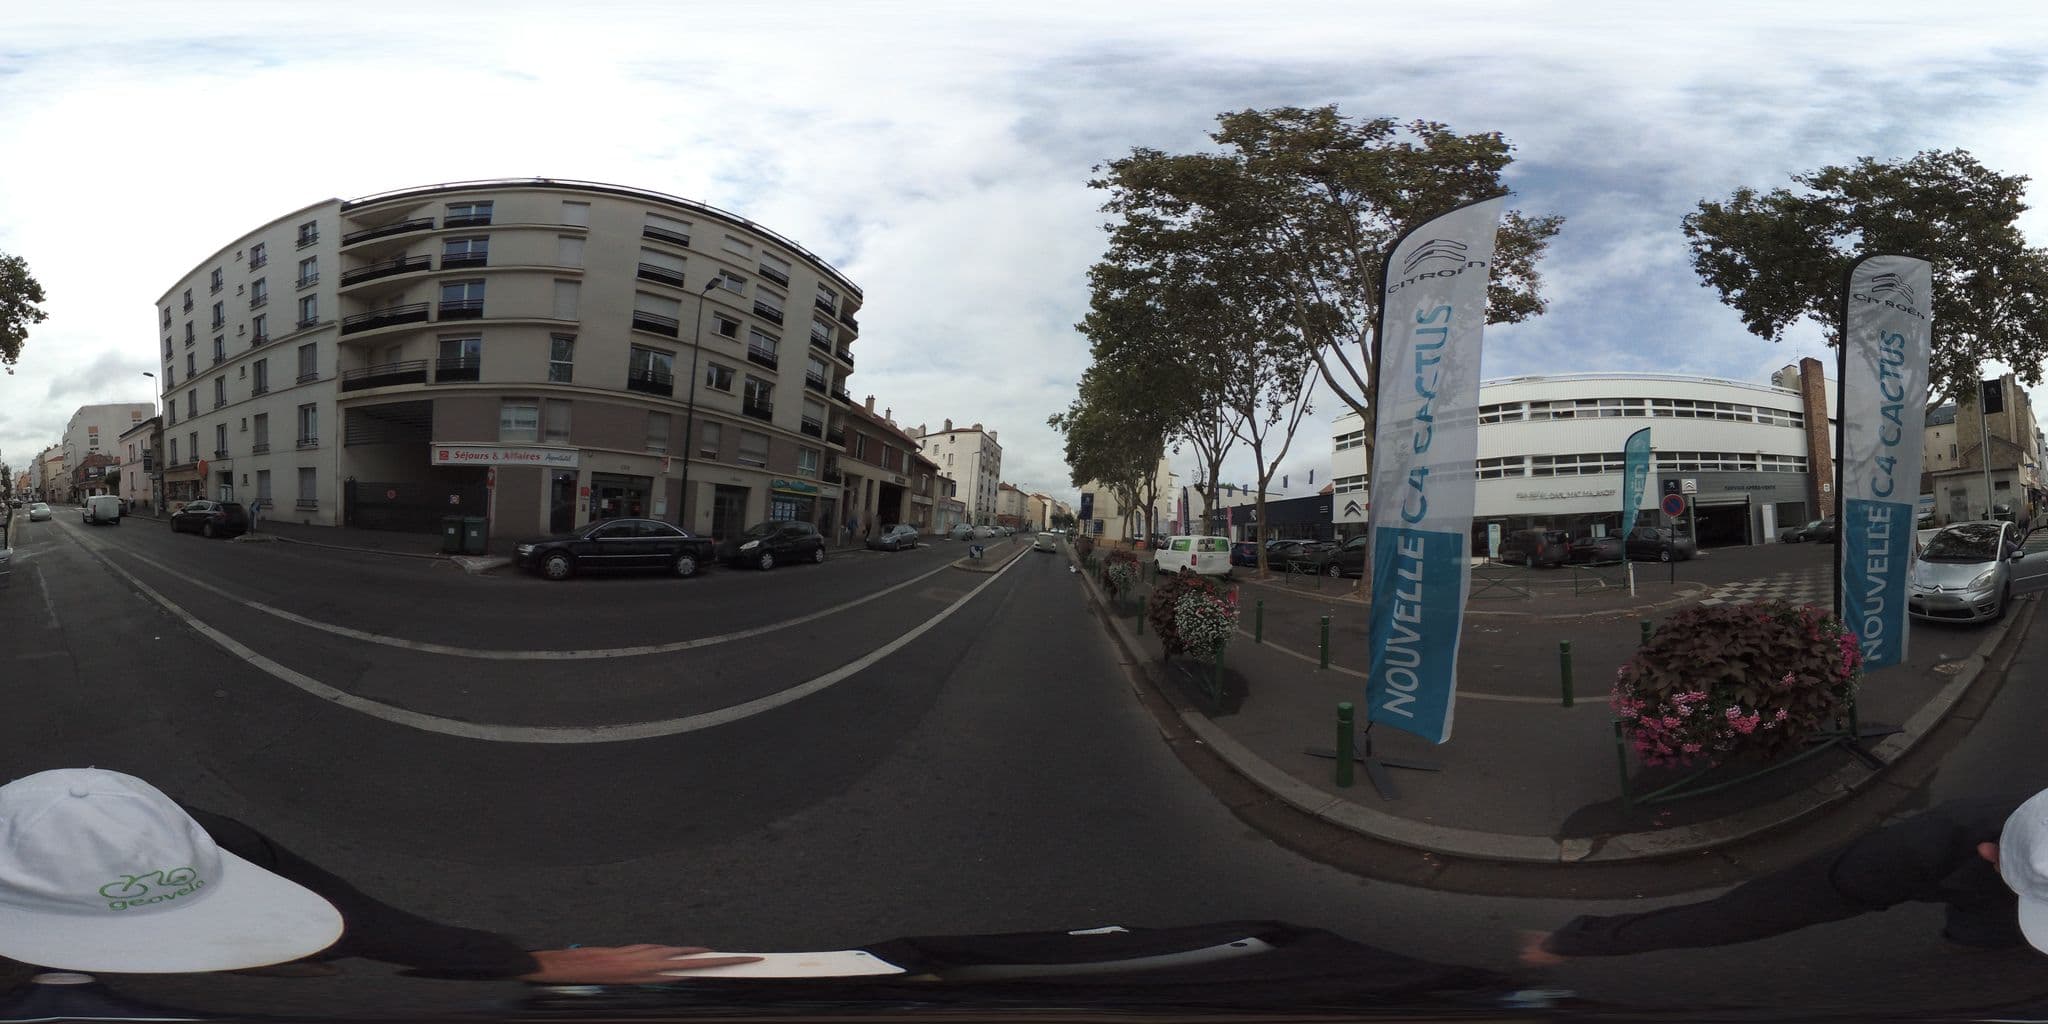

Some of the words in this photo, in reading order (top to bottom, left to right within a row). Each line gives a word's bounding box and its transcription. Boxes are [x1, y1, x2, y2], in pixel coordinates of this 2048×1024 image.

[1413, 304, 1452, 454] CACTUS
[1878, 329, 1905, 447] CACTUS
[454, 450, 489, 460] Séjours
[502, 450, 541, 461] Affaires
[1401, 465, 1430, 524] C4
[1871, 455, 1897, 498] C4
[1382, 535, 1425, 719] NOUVELLE
[1862, 505, 1892, 661] NOUVELLE
[109, 880, 205, 910] geovelo
